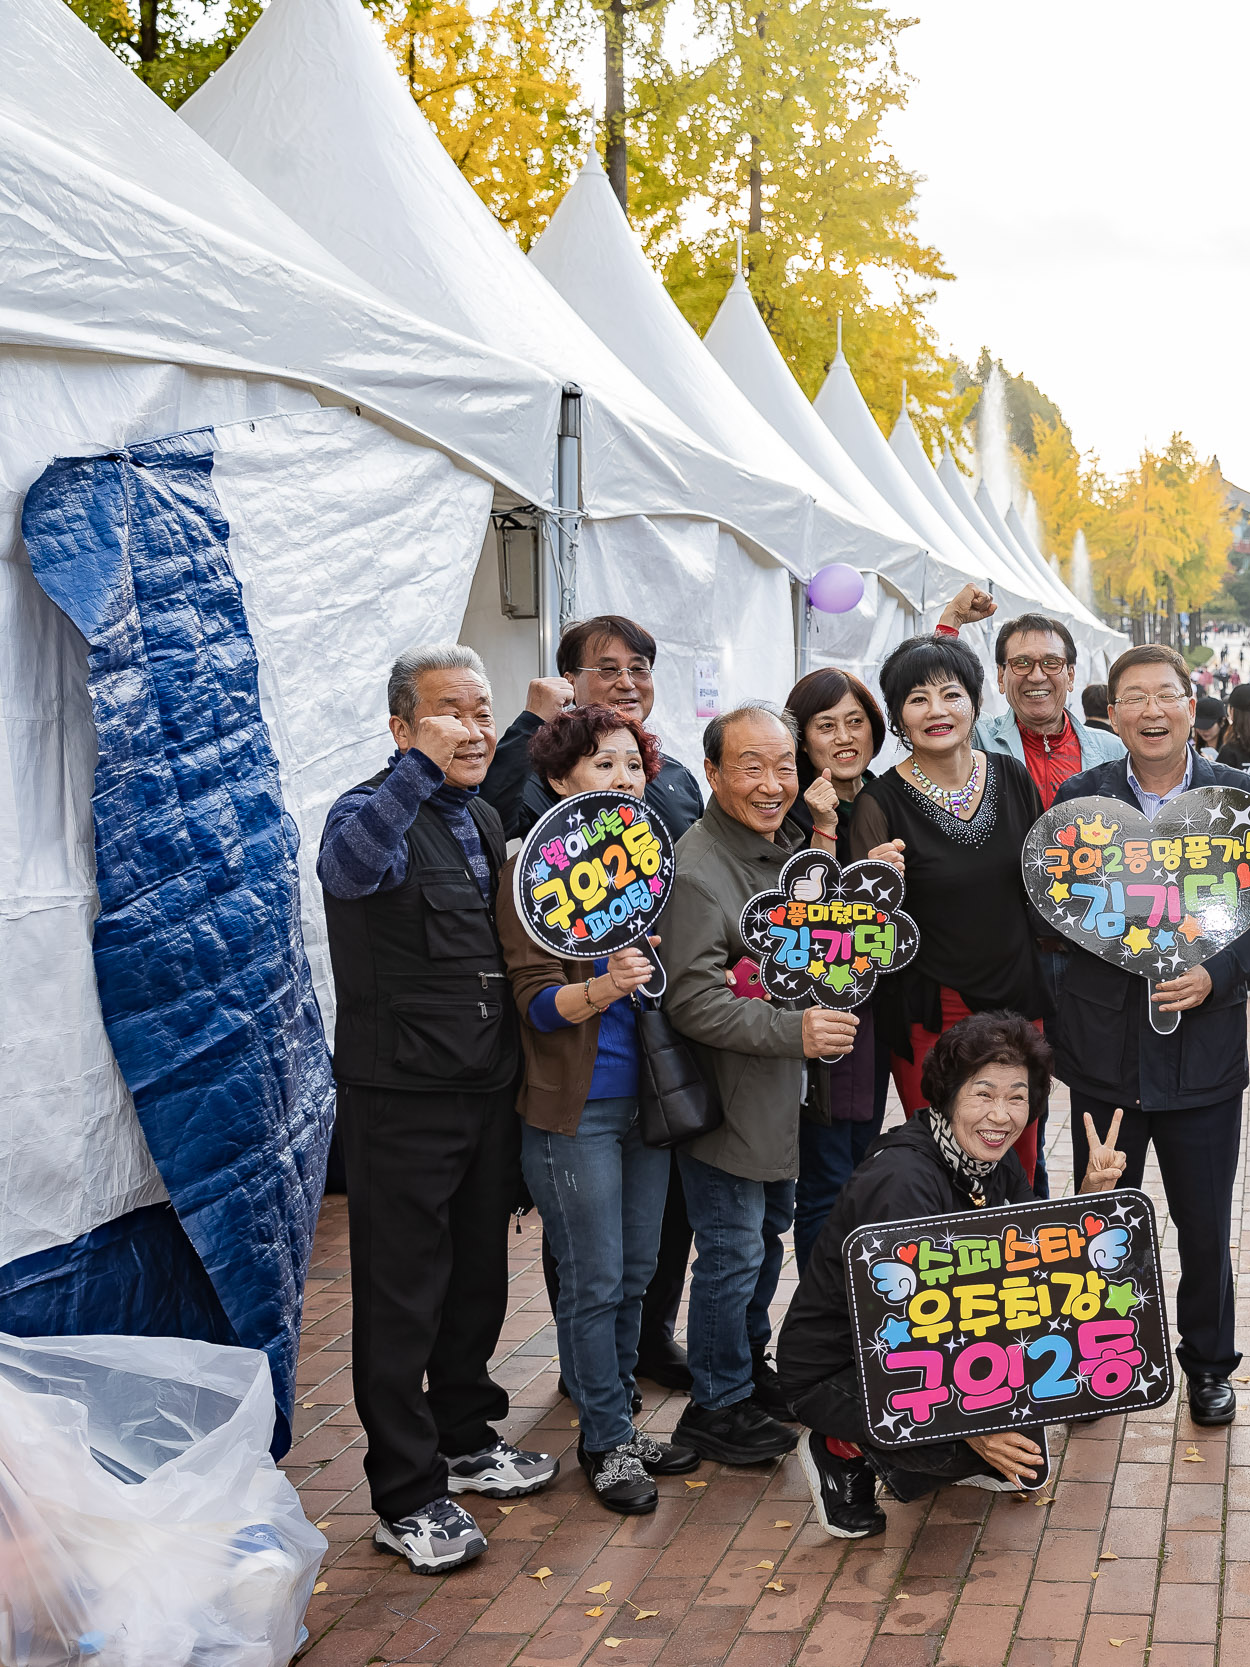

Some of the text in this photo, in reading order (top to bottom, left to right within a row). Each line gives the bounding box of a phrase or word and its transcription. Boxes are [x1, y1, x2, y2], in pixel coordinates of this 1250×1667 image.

[542, 811, 625, 871] 빛이나는
[533, 821, 661, 930] 구의2동
[583, 879, 652, 940] 파이팅
[769, 924, 895, 969] 김기덕
[918, 1227, 1086, 1286] 슈퍼스타
[908, 1271, 1106, 1344] 우주최강
[886, 1319, 1142, 1422] 구의2동
